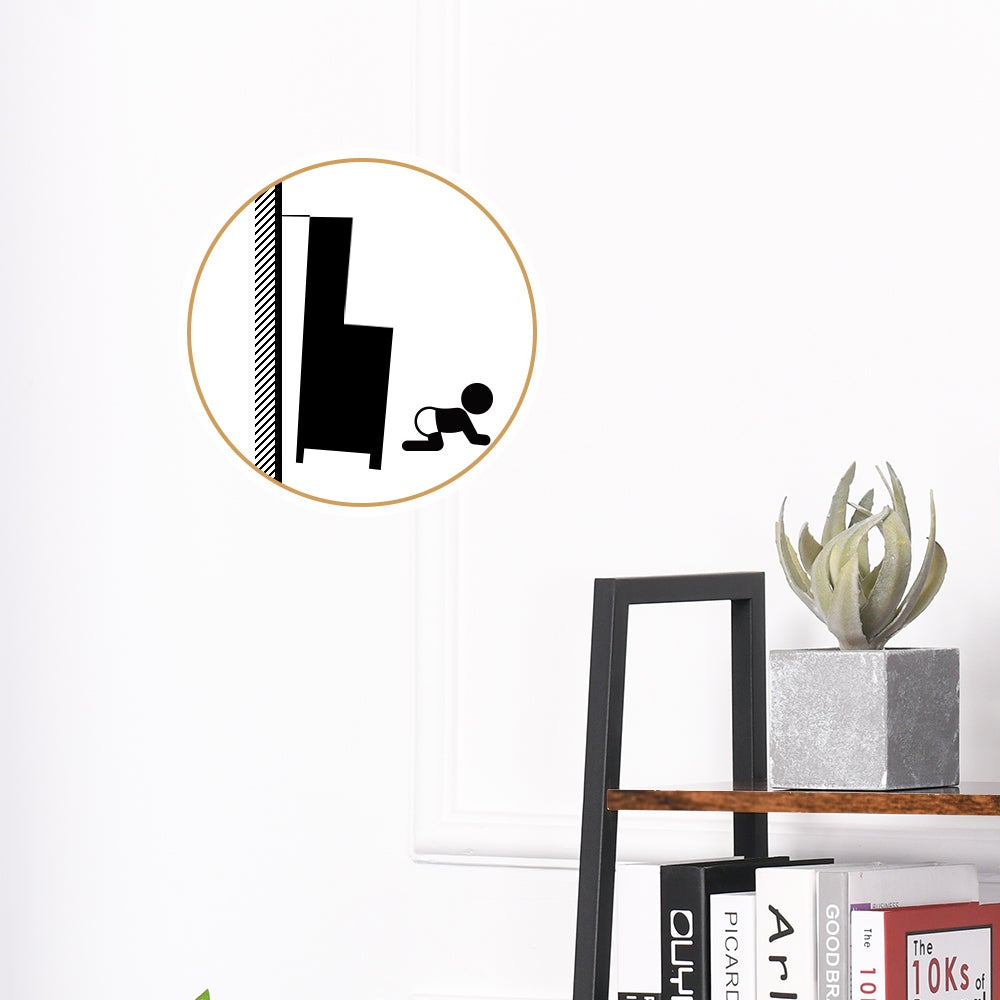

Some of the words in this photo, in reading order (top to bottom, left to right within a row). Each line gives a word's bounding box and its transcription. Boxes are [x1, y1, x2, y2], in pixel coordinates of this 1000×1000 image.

[864, 928, 872, 948] The
[913, 939, 933, 956] The
[912, 956, 970, 995] 10Ks
[975, 973, 985, 990] of
